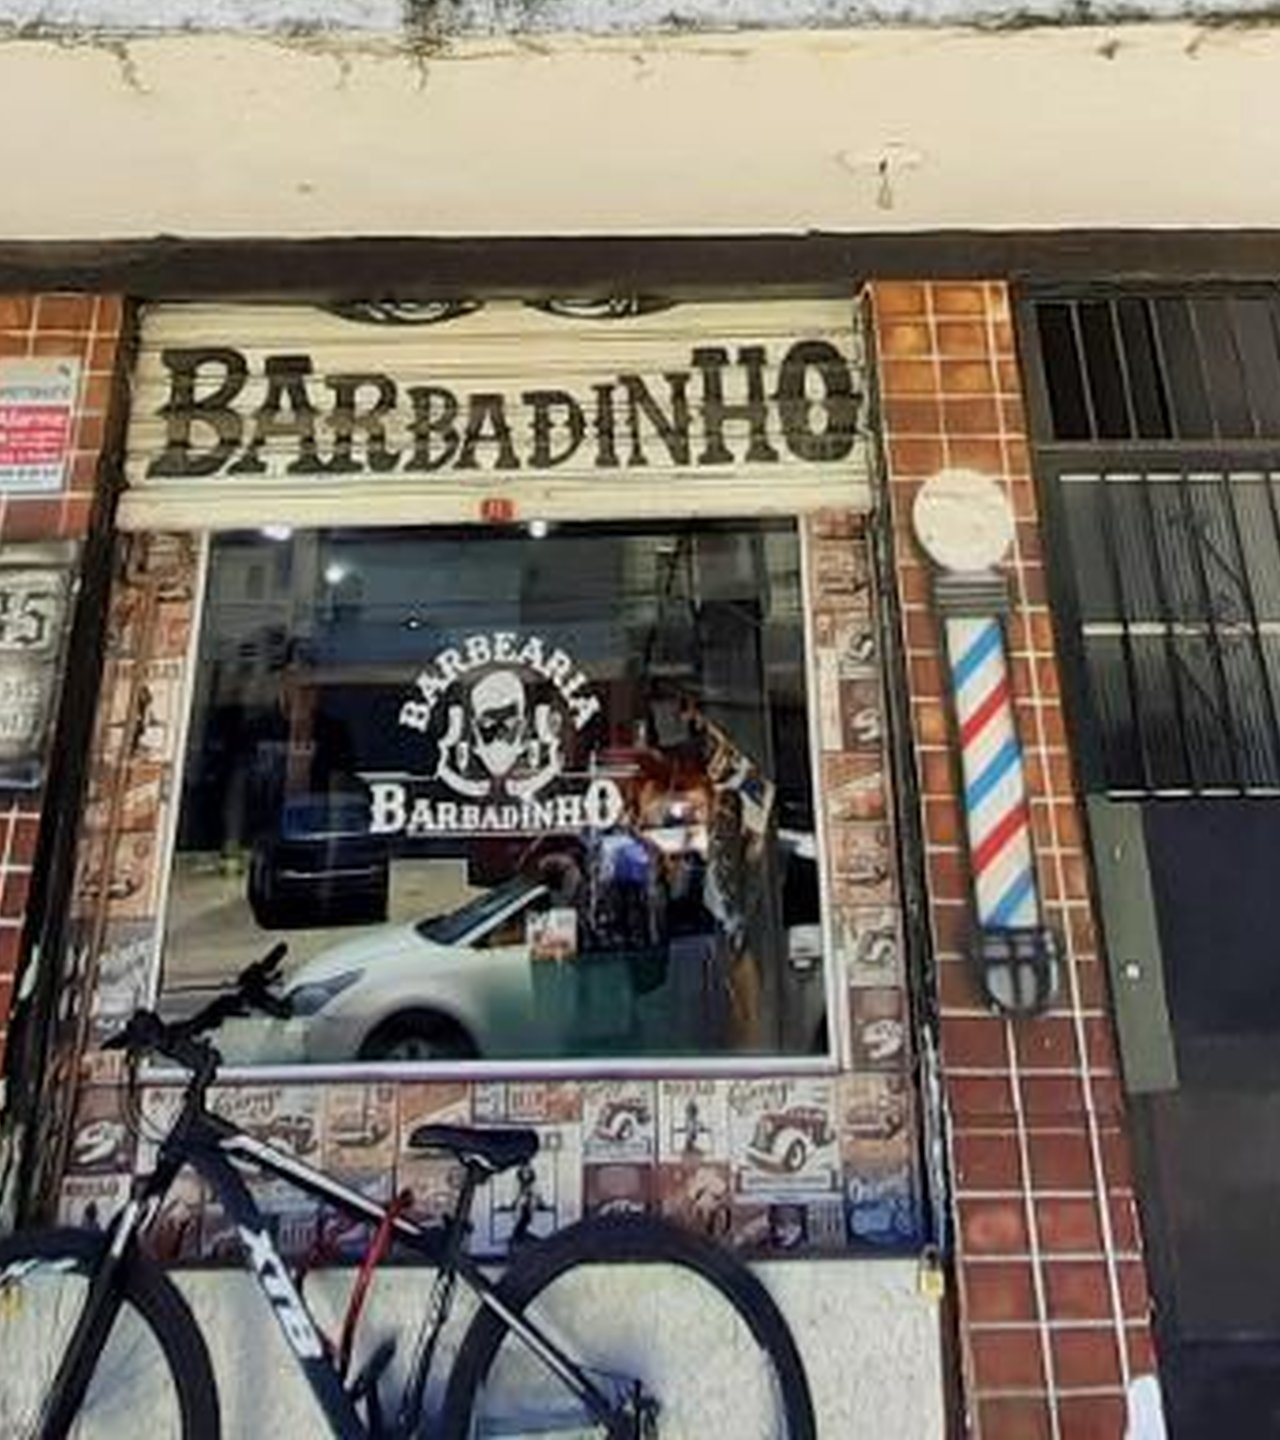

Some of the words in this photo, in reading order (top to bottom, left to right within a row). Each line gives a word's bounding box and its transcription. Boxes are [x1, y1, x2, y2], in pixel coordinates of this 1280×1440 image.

[146, 340, 864, 479] BARBADINHO
[399, 632, 601, 733] BARBEARIA
[370, 778, 624, 834] BARBADINHO
